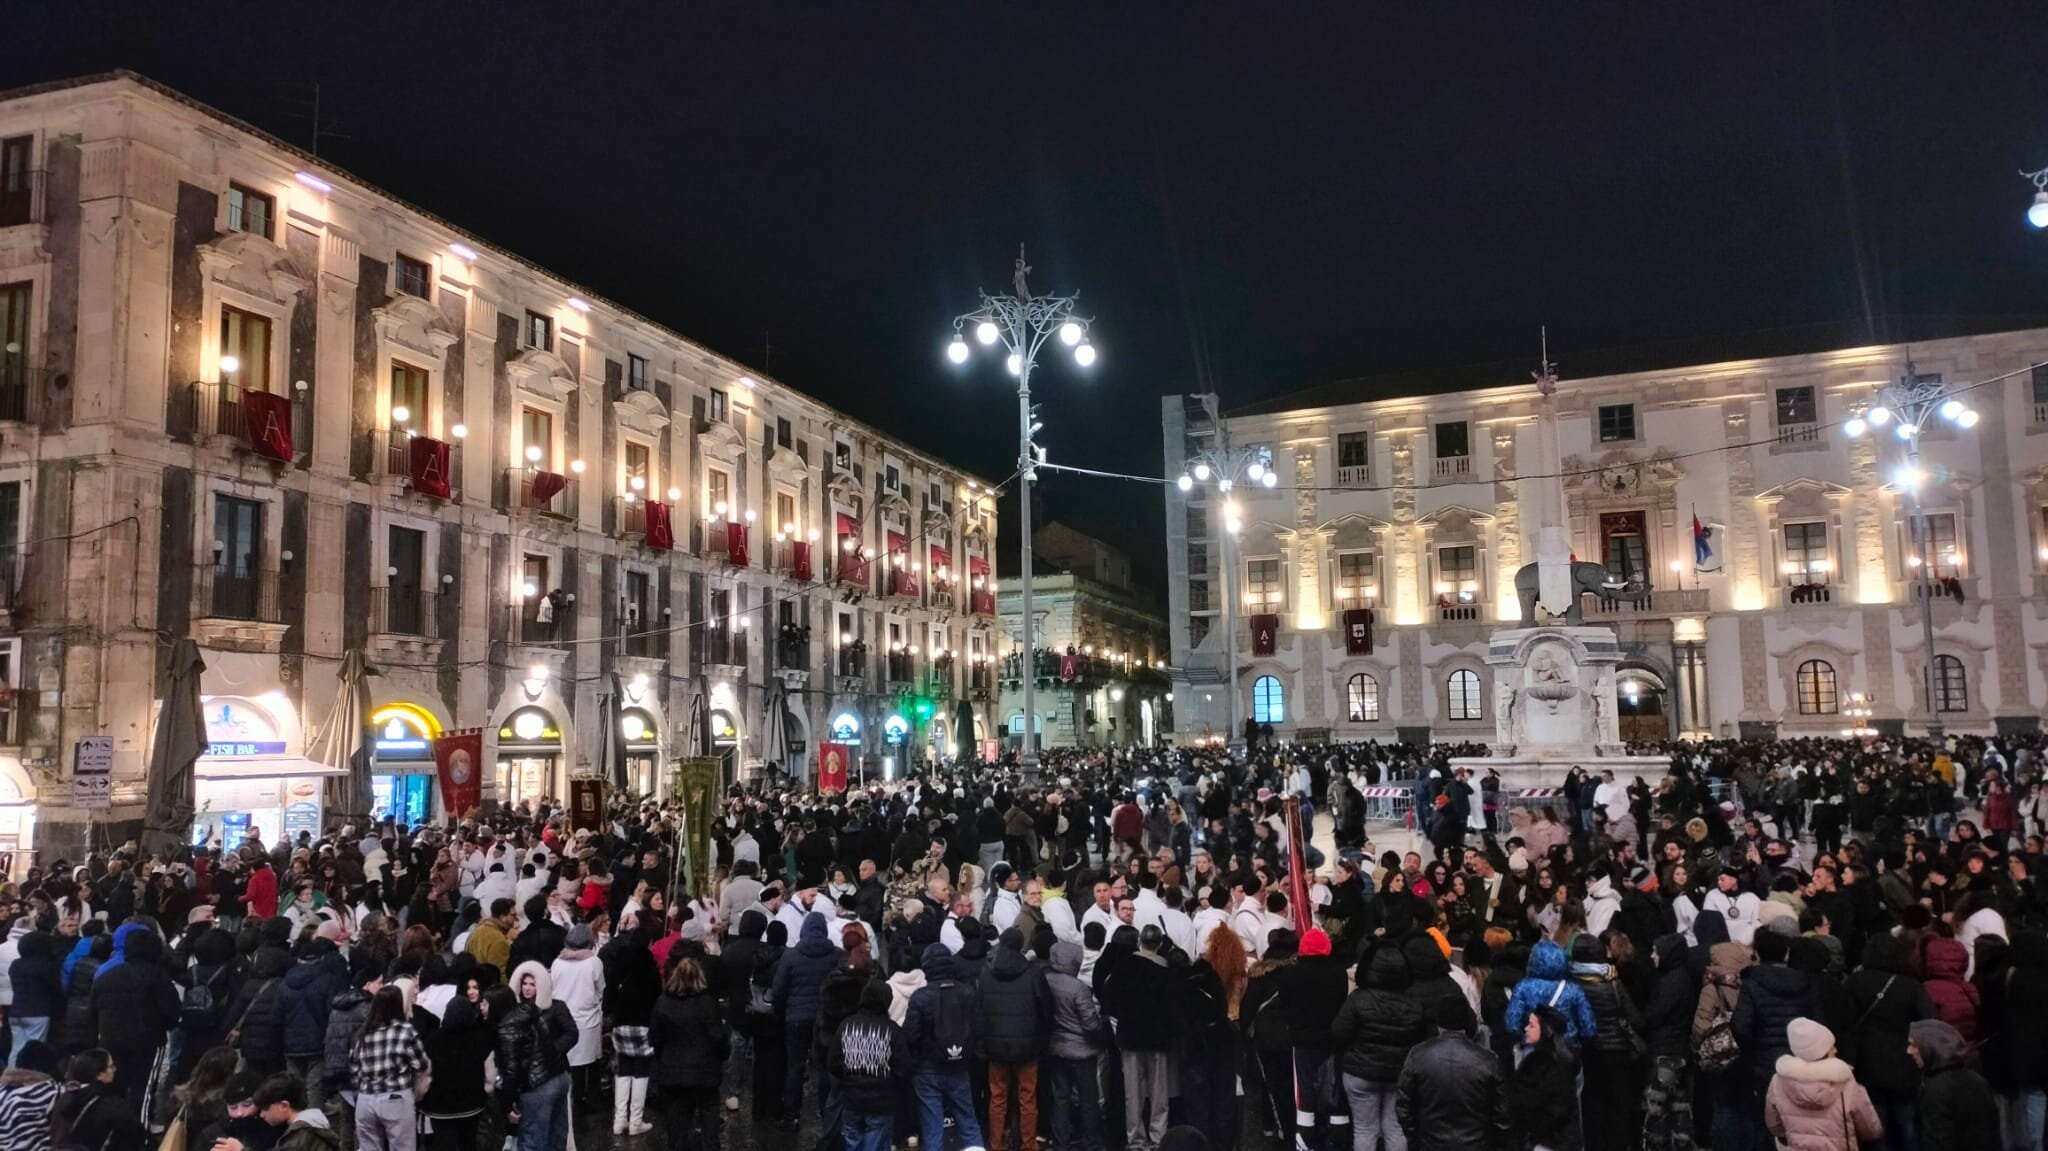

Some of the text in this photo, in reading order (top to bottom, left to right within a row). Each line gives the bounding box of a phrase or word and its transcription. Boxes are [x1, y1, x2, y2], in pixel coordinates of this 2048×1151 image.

[262, 409, 287, 449] A
[421, 453, 446, 486] A
[856, 568, 863, 580] A
[905, 580, 913, 591] A
[1260, 629, 1269, 640] A
[1064, 660, 1074, 675] A
